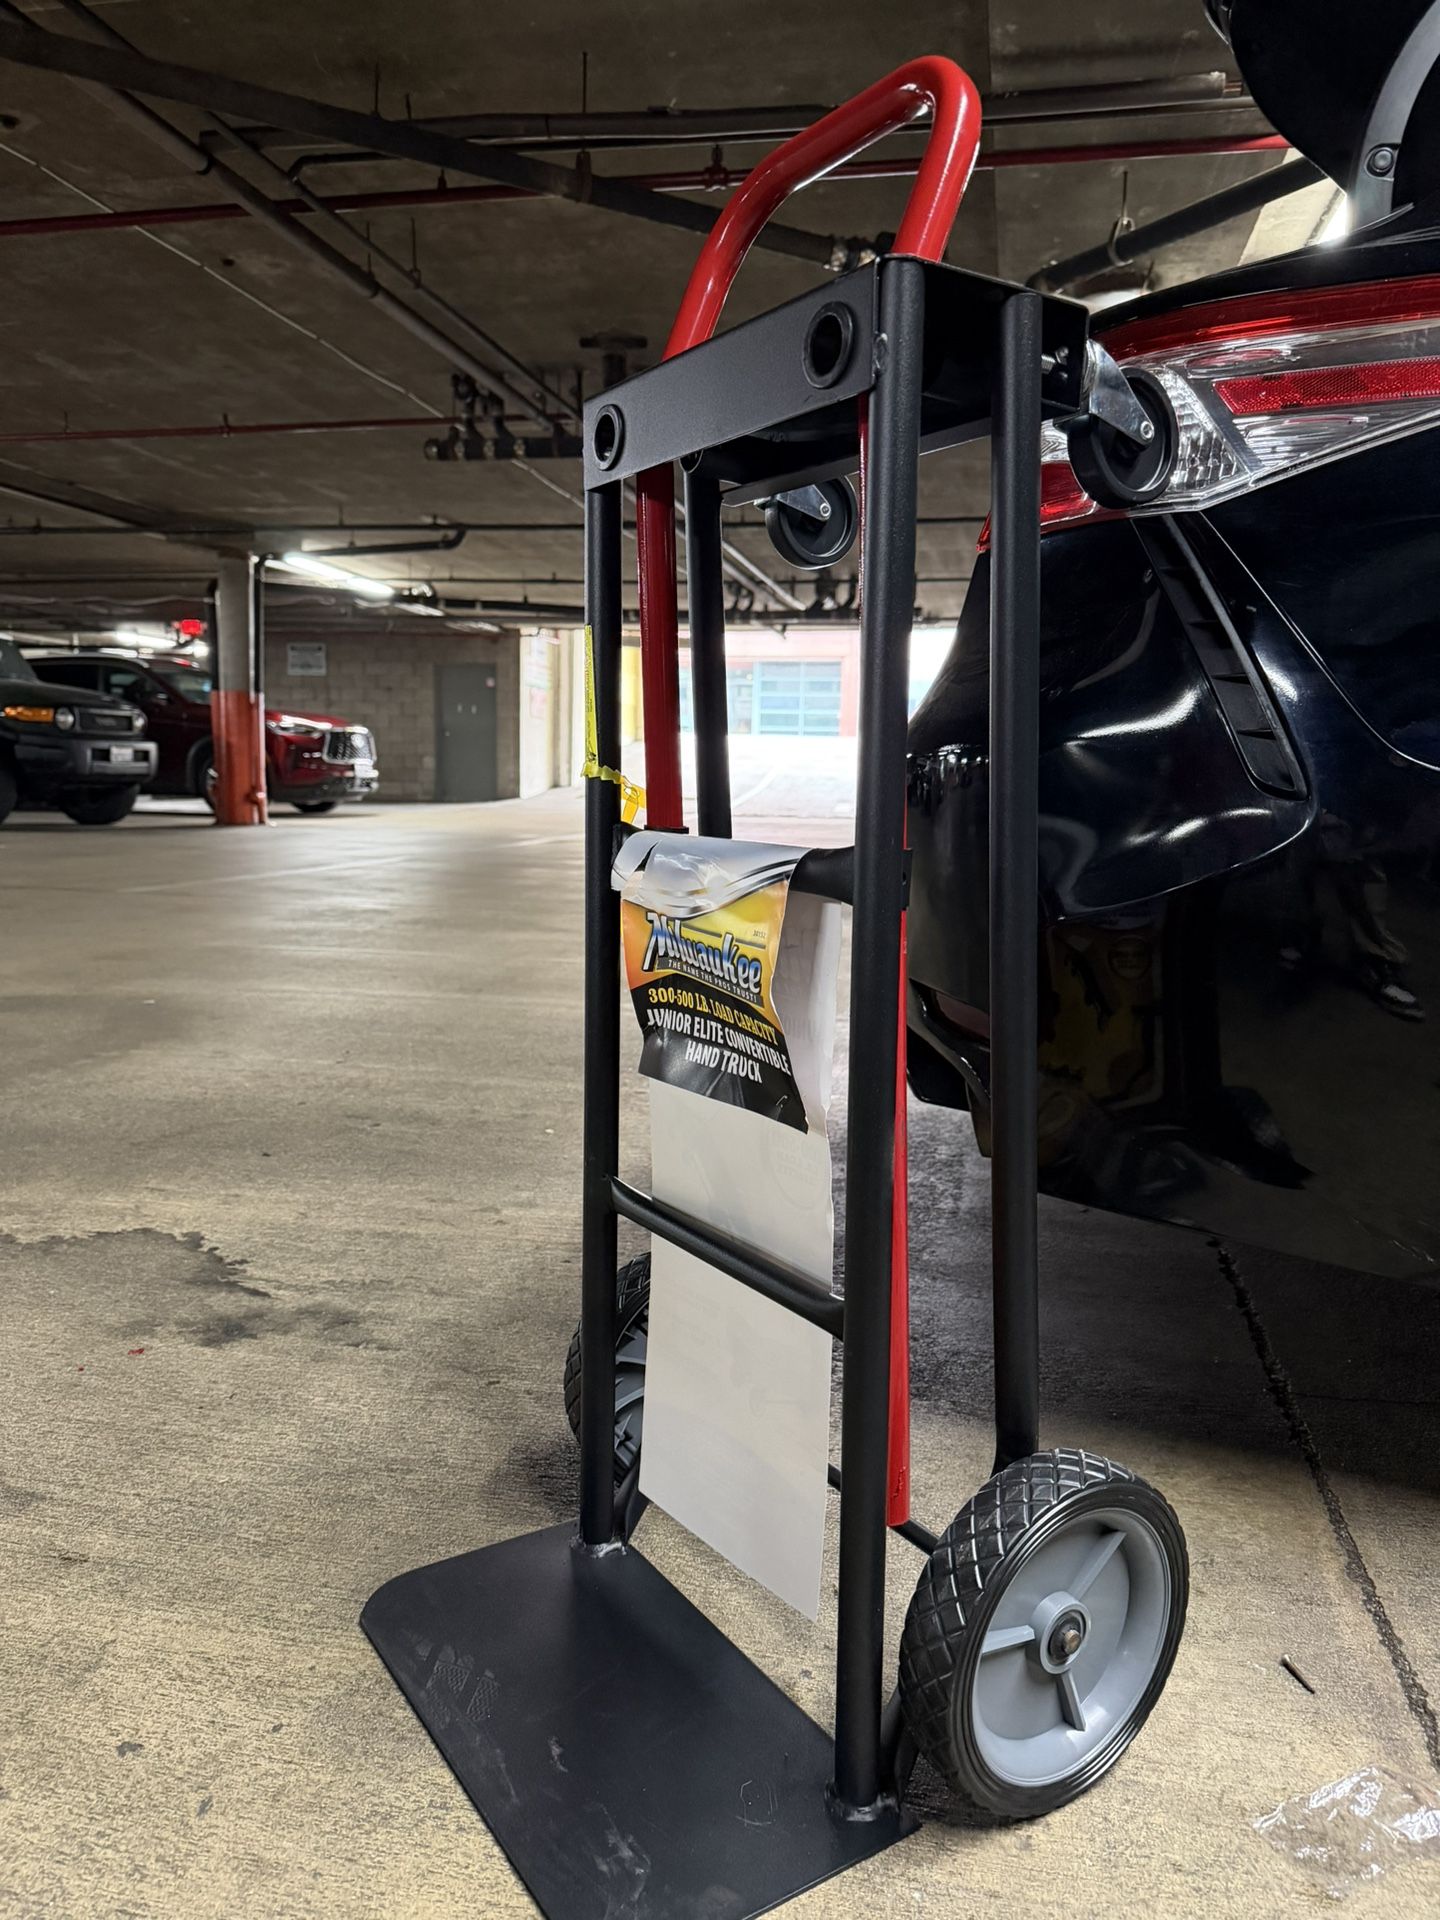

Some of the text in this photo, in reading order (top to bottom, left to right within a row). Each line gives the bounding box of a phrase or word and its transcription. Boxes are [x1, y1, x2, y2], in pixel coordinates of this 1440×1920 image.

[642, 911, 762, 993] Milwaukee
[668, 959, 681, 970] THE
[683, 964, 700, 978] NAME
[701, 970, 713, 984] THE
[714, 976, 731, 991] PROS
[647, 1009, 791, 1076] JUNIOR ELITE CONVERTIBLE
[648, 988, 779, 1045] 300-500 LB. LOAD CAPACITY
[685, 1041, 763, 1084] HAND TRUCK
